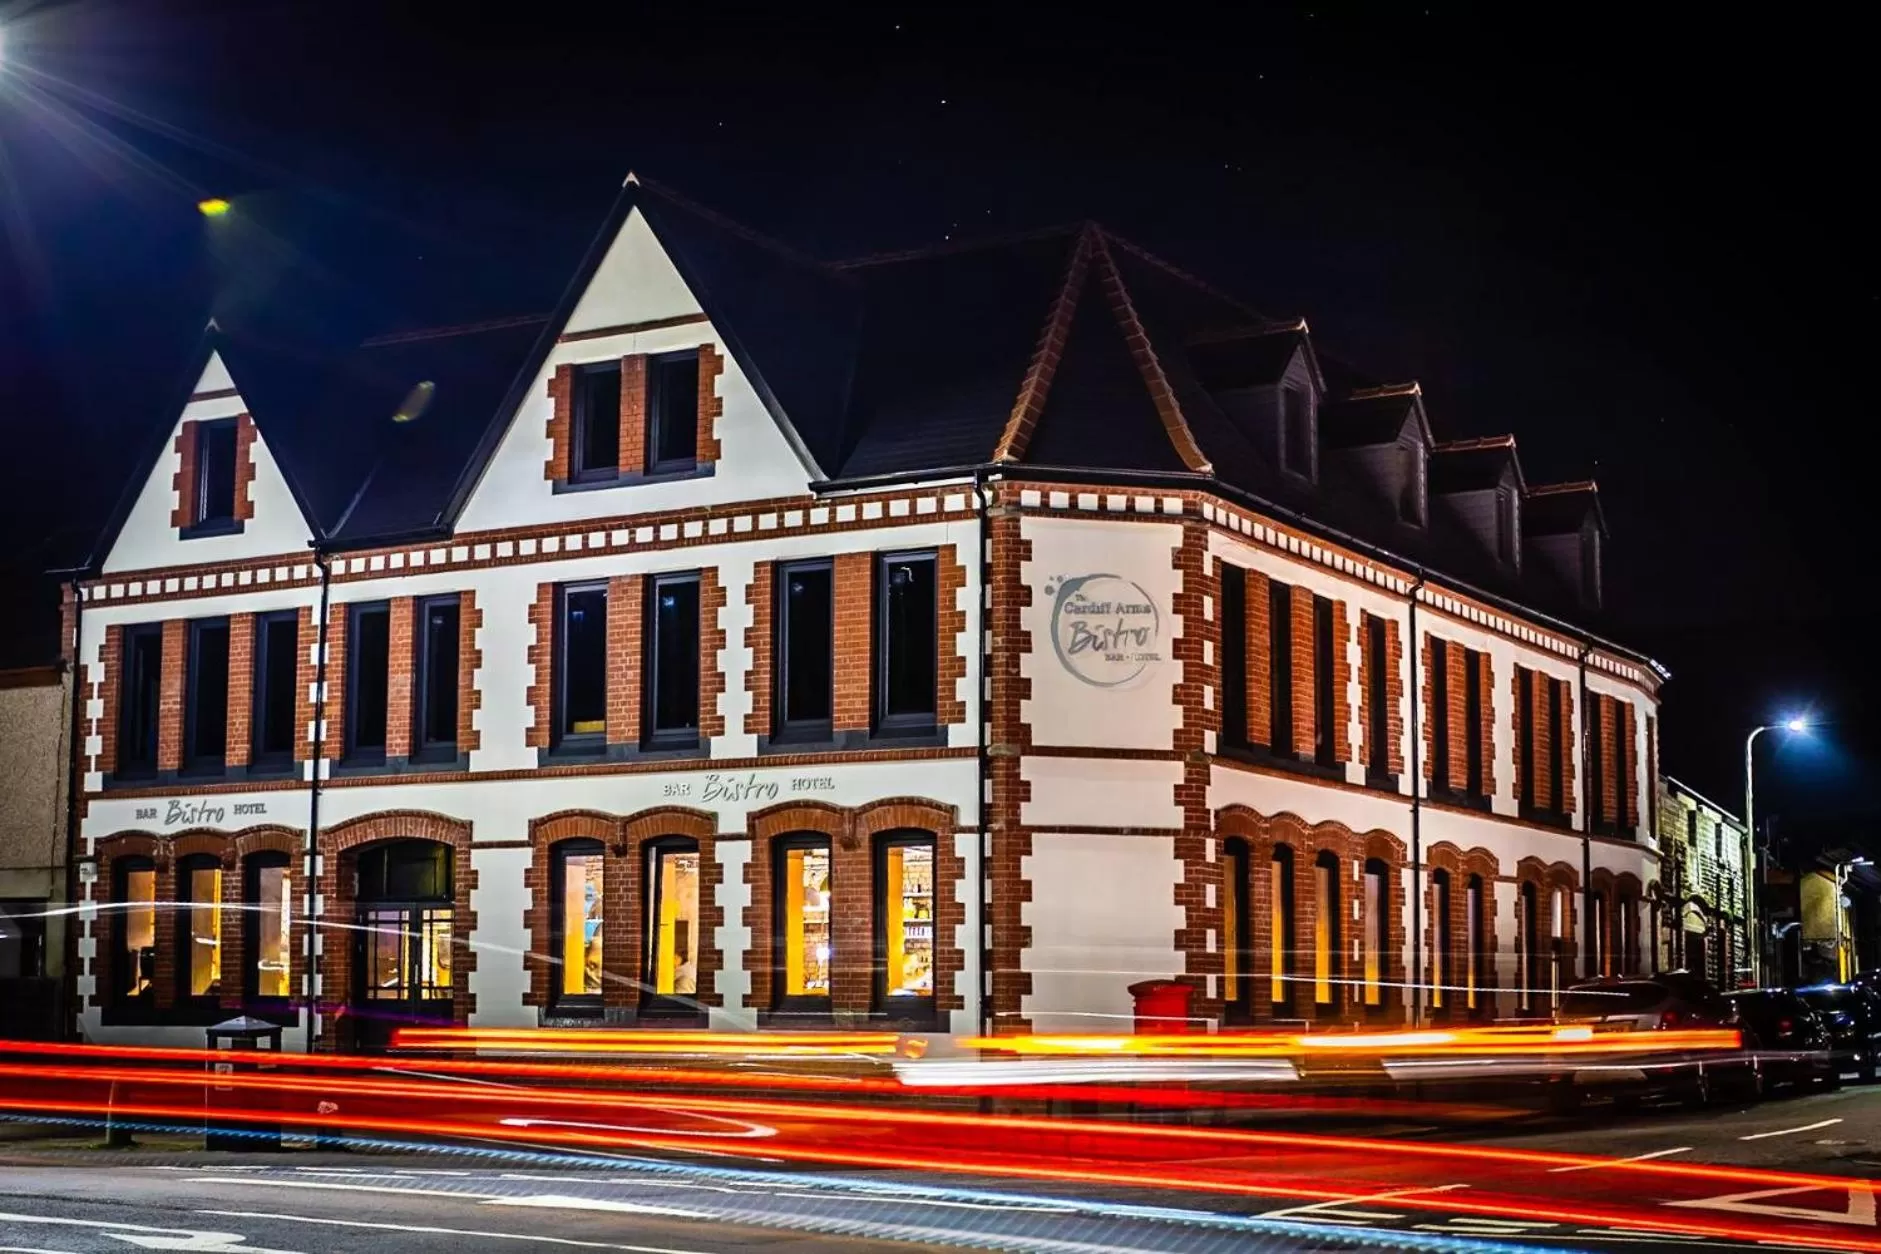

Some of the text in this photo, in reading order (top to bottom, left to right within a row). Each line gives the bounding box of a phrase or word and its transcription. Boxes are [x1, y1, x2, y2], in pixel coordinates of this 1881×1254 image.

[1064, 601, 1152, 615] Cardiff Arms
[1068, 618, 1150, 655] Bistro
[663, 773, 836, 802] BAR Bistro HOTEL
[135, 799, 267, 825] BAR Bistro HOTEL
